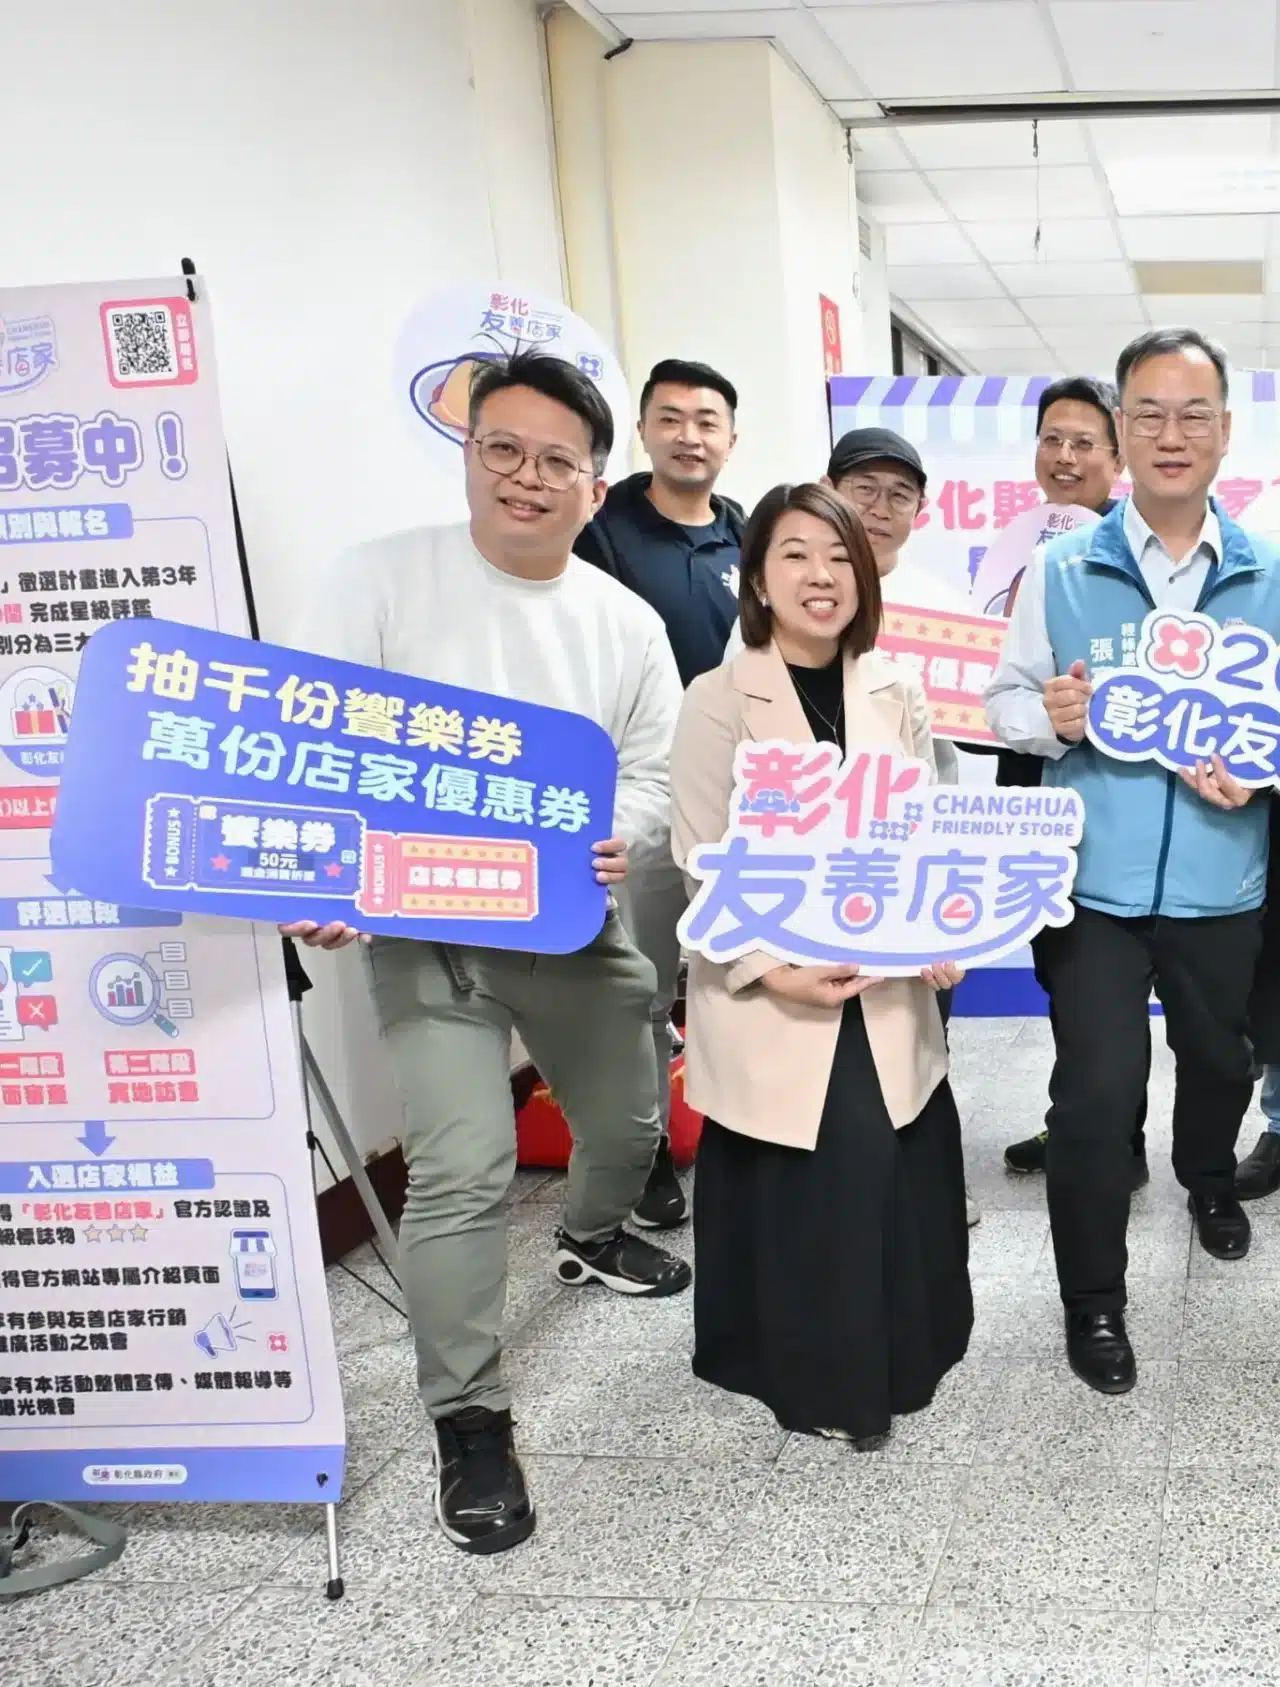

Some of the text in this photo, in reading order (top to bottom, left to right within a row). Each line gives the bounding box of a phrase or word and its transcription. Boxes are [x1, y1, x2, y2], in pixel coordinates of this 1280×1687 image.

[491, 293, 529, 316] 彰化
[0, 343, 54, 377] 店家
[125, 642, 523, 766] 抽千份饗樂券
[20, 751, 65, 765] 彰化友
[142, 710, 592, 834] 萬份店家優惠券
[739, 748, 921, 839] 彰化
[933, 794, 1078, 817] CHANGHUA
[931, 820, 1075, 836] FRIENDLY STORE
[259, 852, 299, 869] 50元
[687, 837, 1071, 966] 友善店家
[0, 1308, 187, 1331] 有參與友善店家行銷
